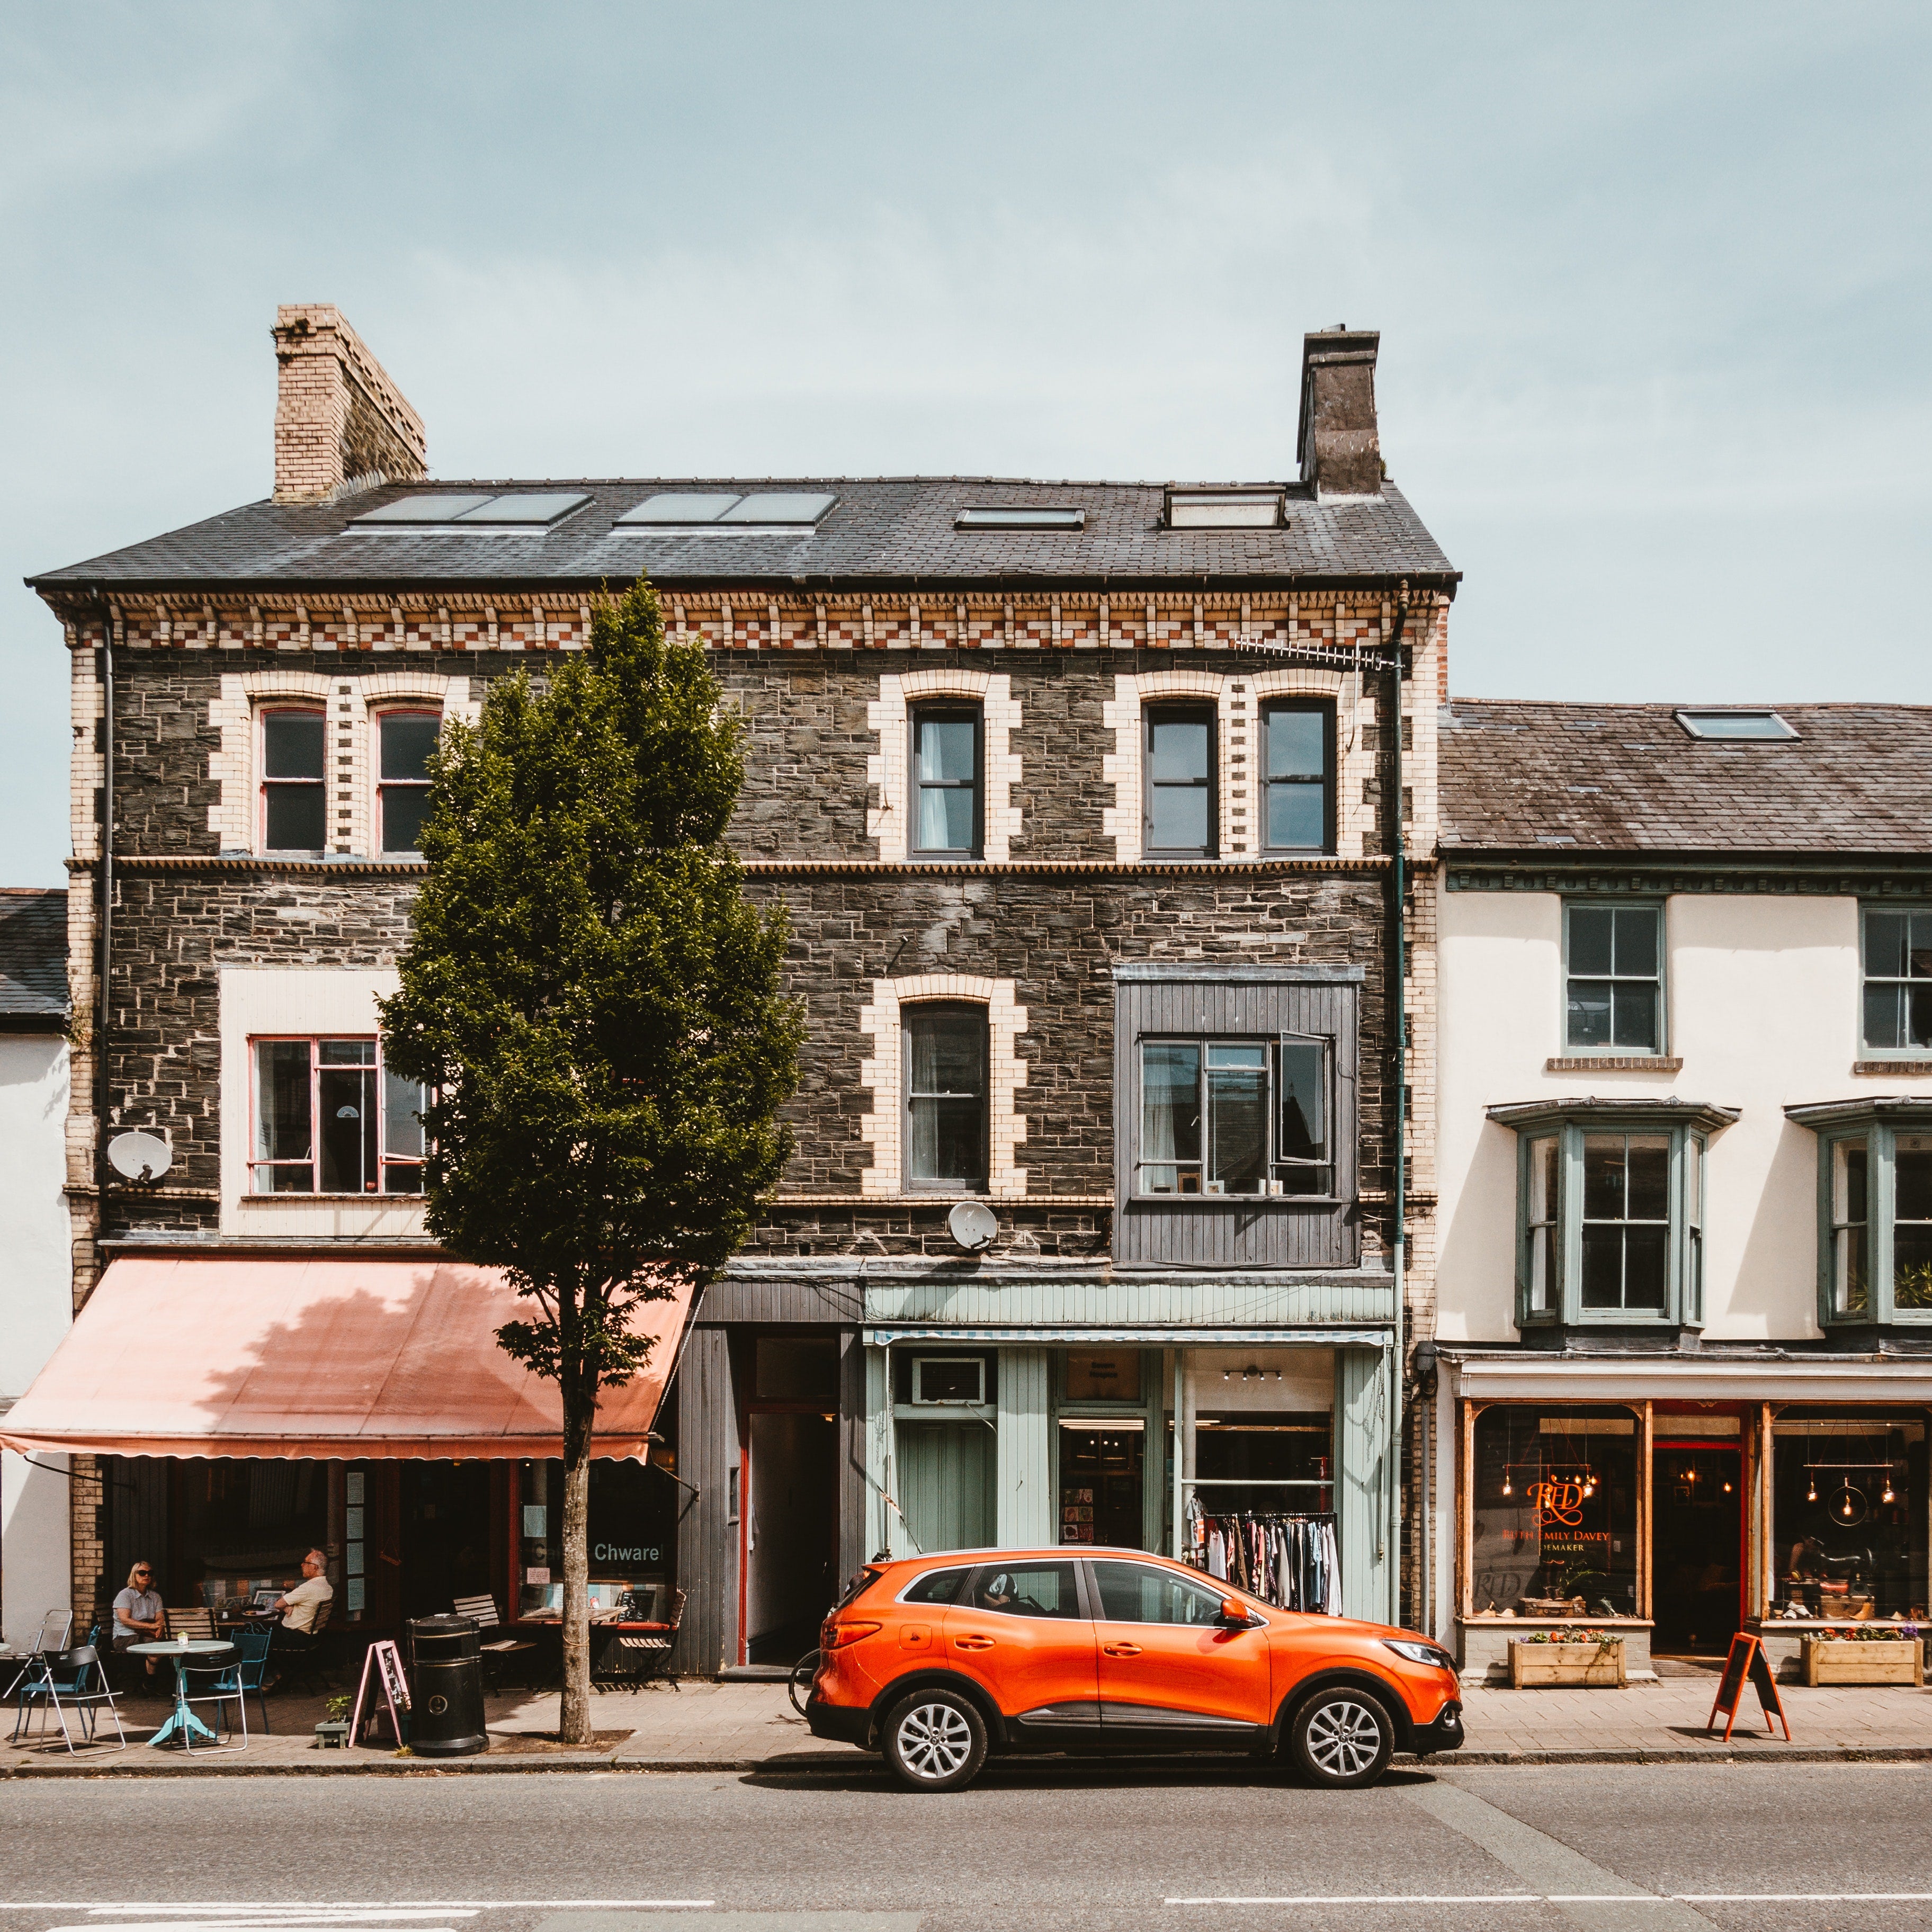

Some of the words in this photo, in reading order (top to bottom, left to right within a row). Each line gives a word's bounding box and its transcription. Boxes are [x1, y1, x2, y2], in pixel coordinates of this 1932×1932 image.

[1527, 1474, 1583, 1526] RED
[1539, 1530, 1570, 1541] EMILY
[1573, 1531, 1610, 1541] DAVEY
